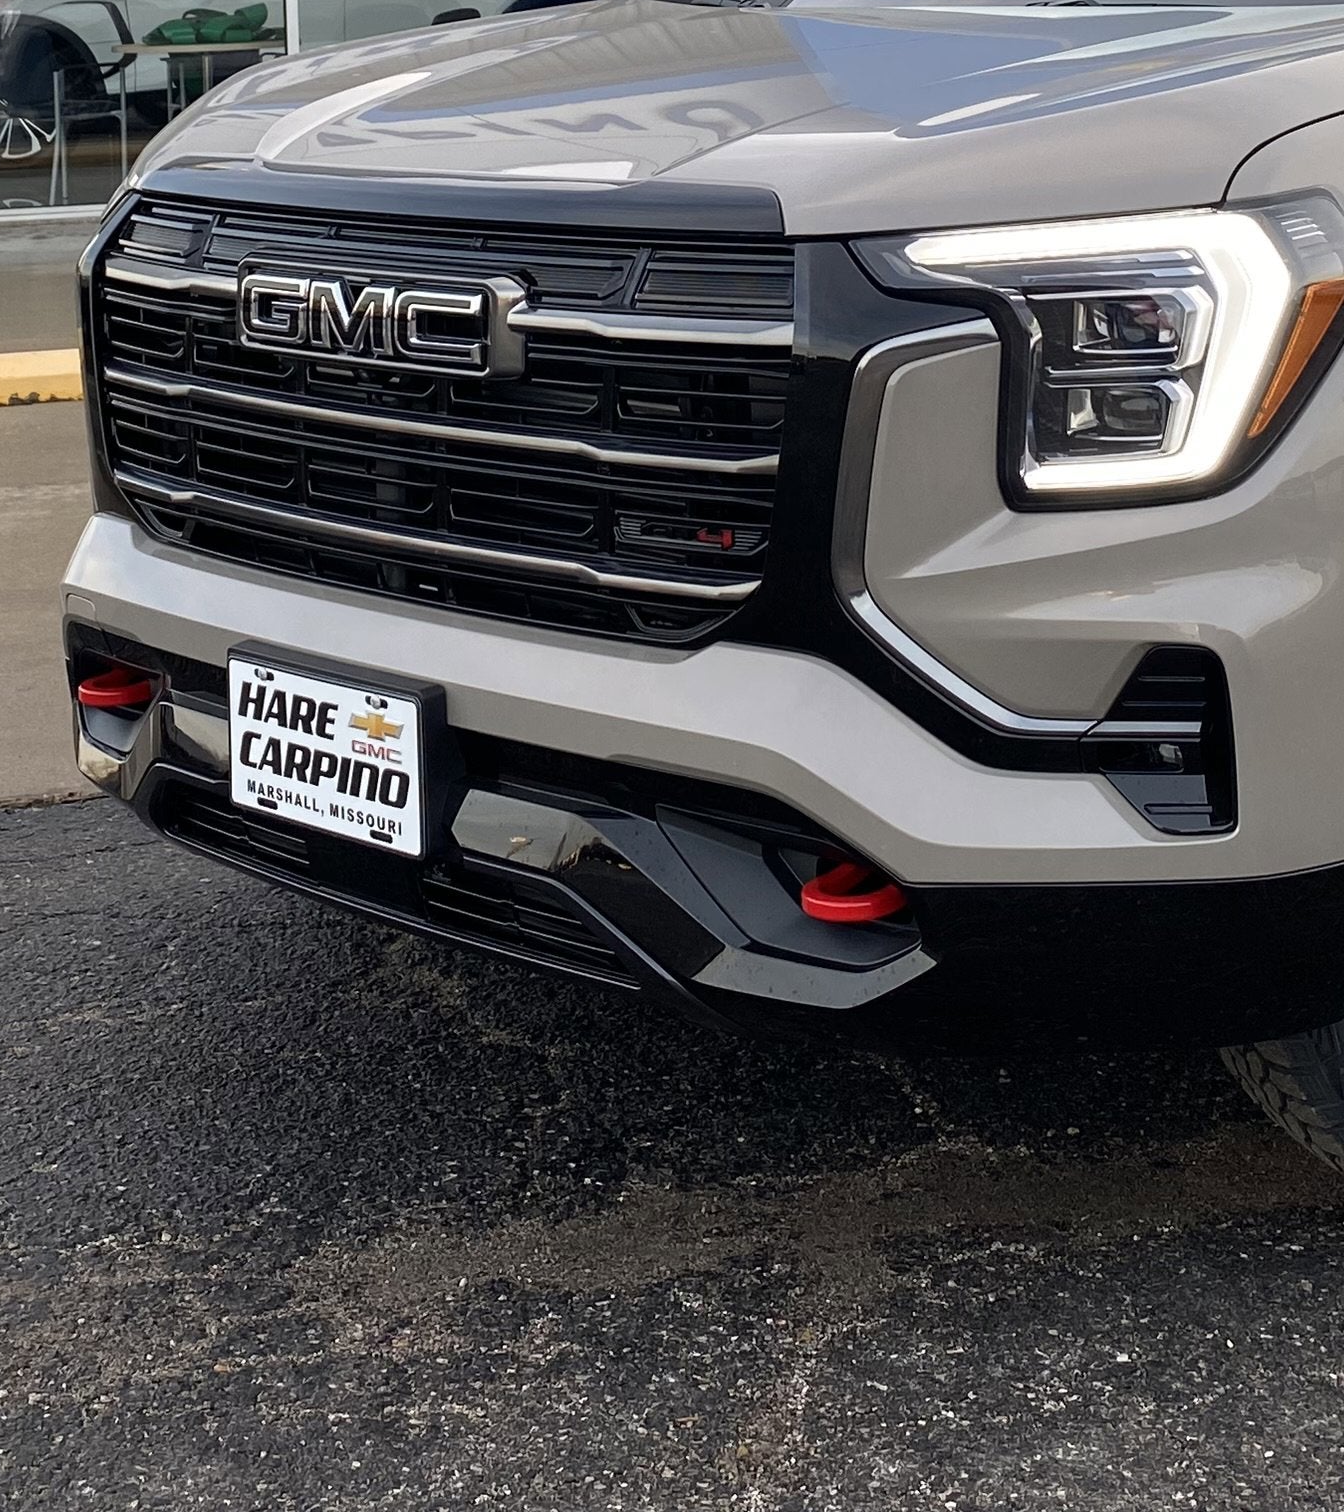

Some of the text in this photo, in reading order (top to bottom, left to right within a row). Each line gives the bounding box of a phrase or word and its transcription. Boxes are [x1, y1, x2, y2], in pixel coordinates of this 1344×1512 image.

[241, 273, 484, 366] GMC
[238, 680, 339, 740] HARE
[239, 729, 411, 810] CARPINO
[351, 739, 403, 765] GMC
[247, 778, 403, 836] MARSHALL, MISSOURI
